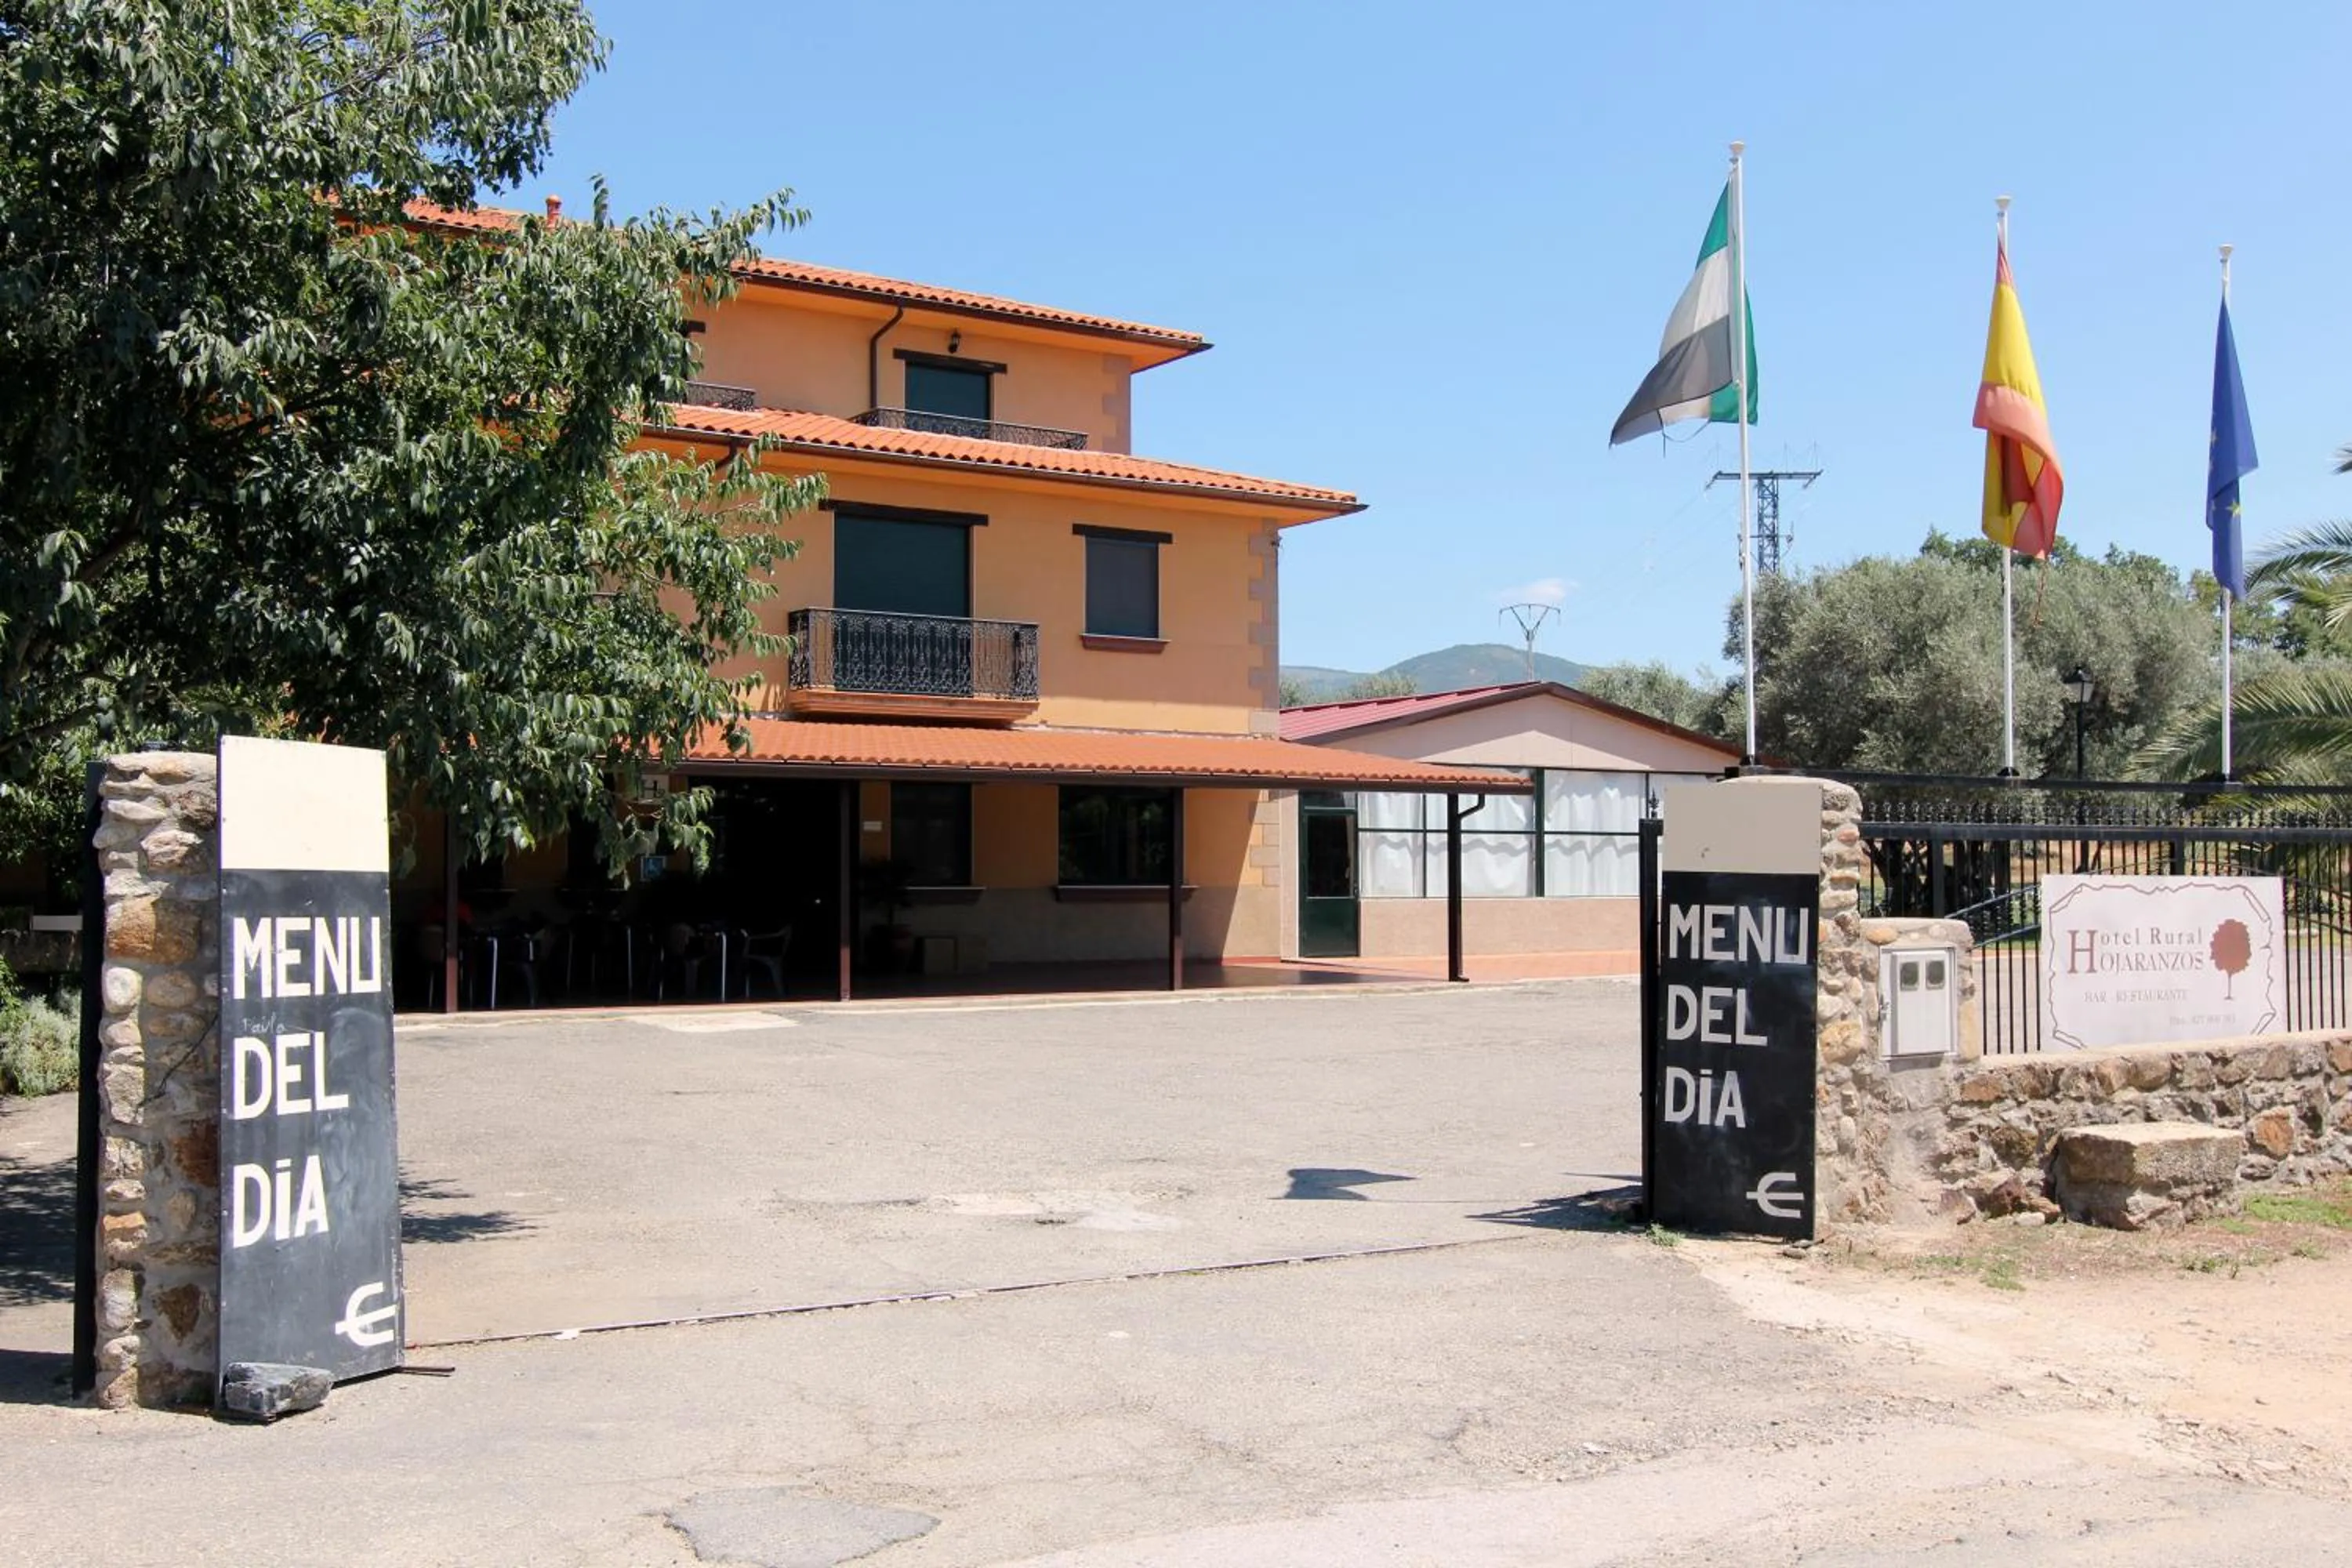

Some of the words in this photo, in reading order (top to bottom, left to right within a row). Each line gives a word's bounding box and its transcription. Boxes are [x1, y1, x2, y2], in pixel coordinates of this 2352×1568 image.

[233, 916, 382, 1000] MENU
[1668, 904, 1809, 965] MENU
[2150, 927, 2202, 946] Rural
[1666, 984, 1769, 1047] DEL
[234, 1031, 350, 1120] DEL
[1746, 1172, 1805, 1218] €
[334, 1281, 398, 1348] €
